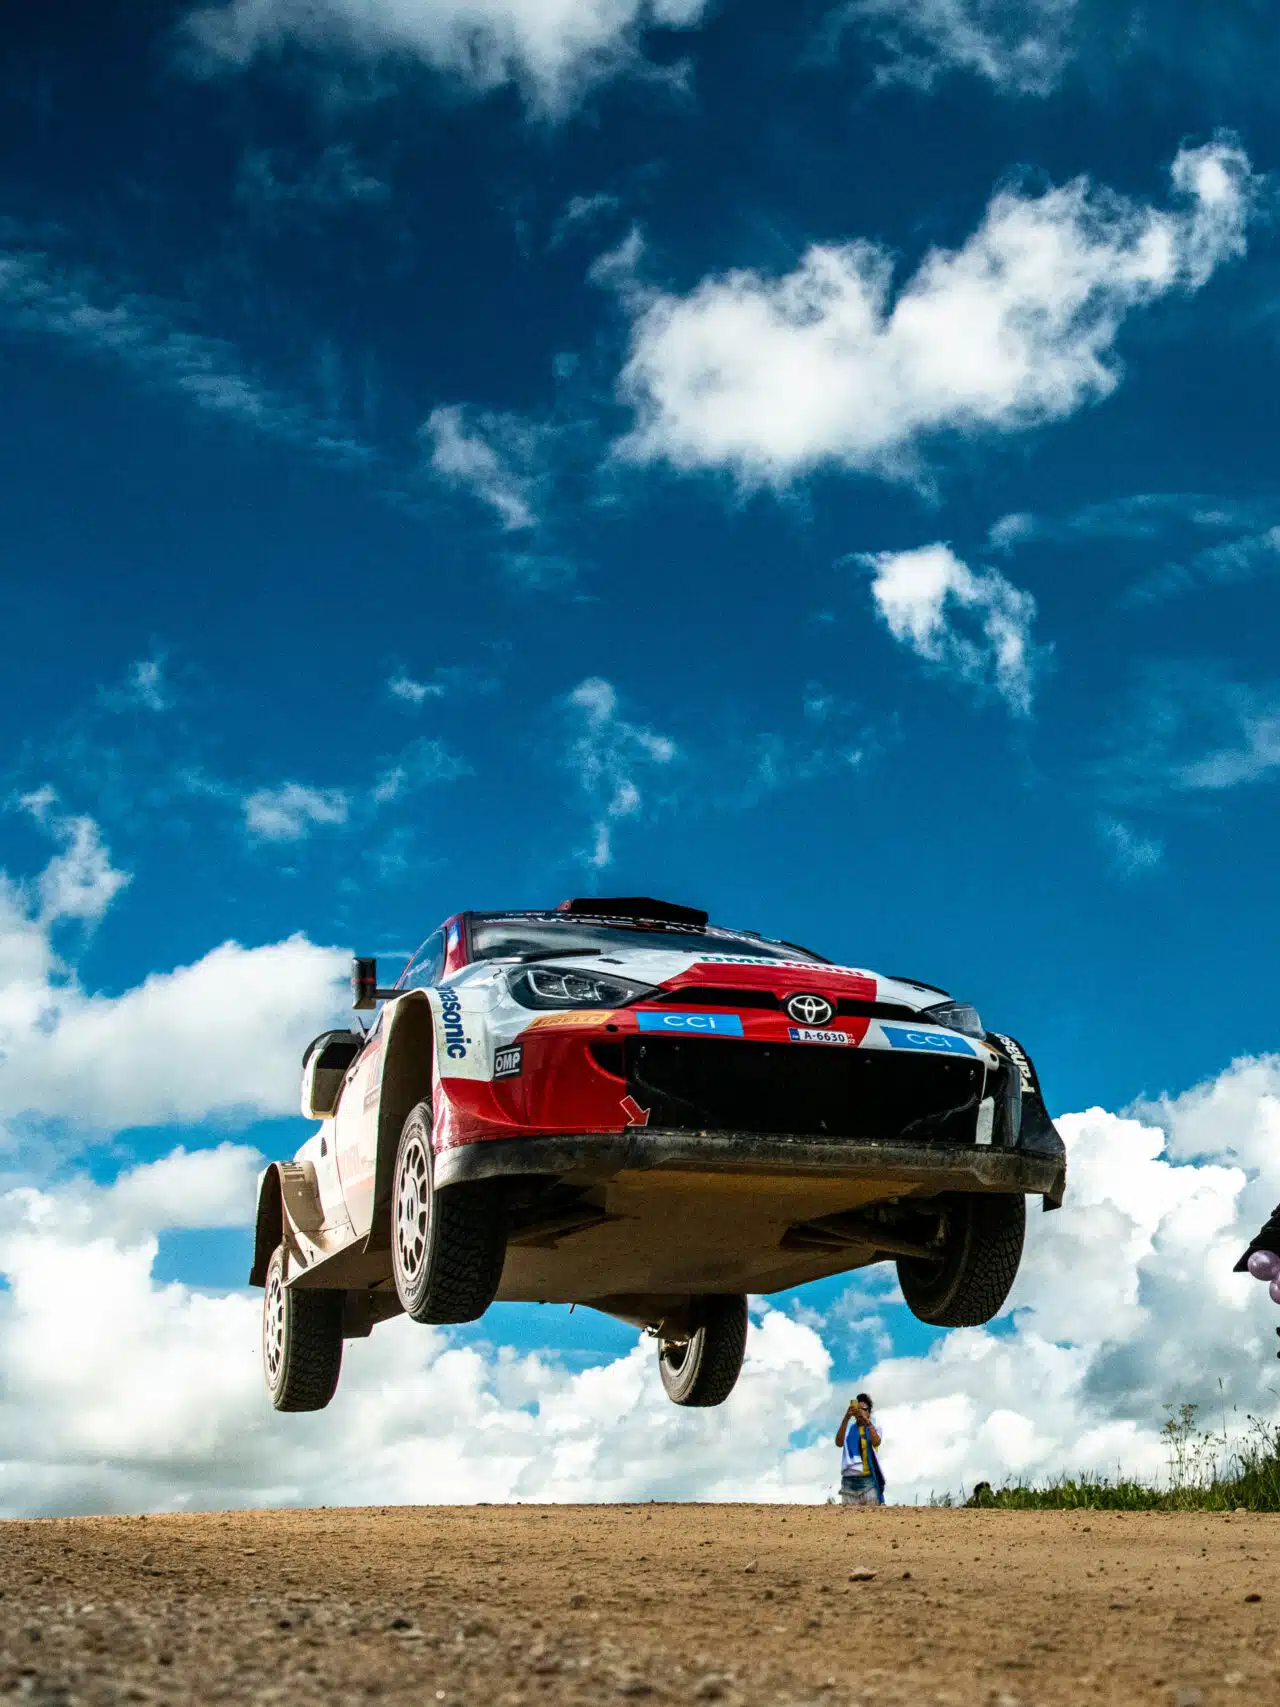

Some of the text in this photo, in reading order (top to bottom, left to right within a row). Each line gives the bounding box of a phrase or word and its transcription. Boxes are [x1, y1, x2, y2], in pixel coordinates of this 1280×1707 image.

[700, 956, 865, 977] DMG MORI
[437, 985, 472, 1059] nasonic
[804, 1030, 846, 1043] A-6630
[495, 1052, 521, 1072] OMP
